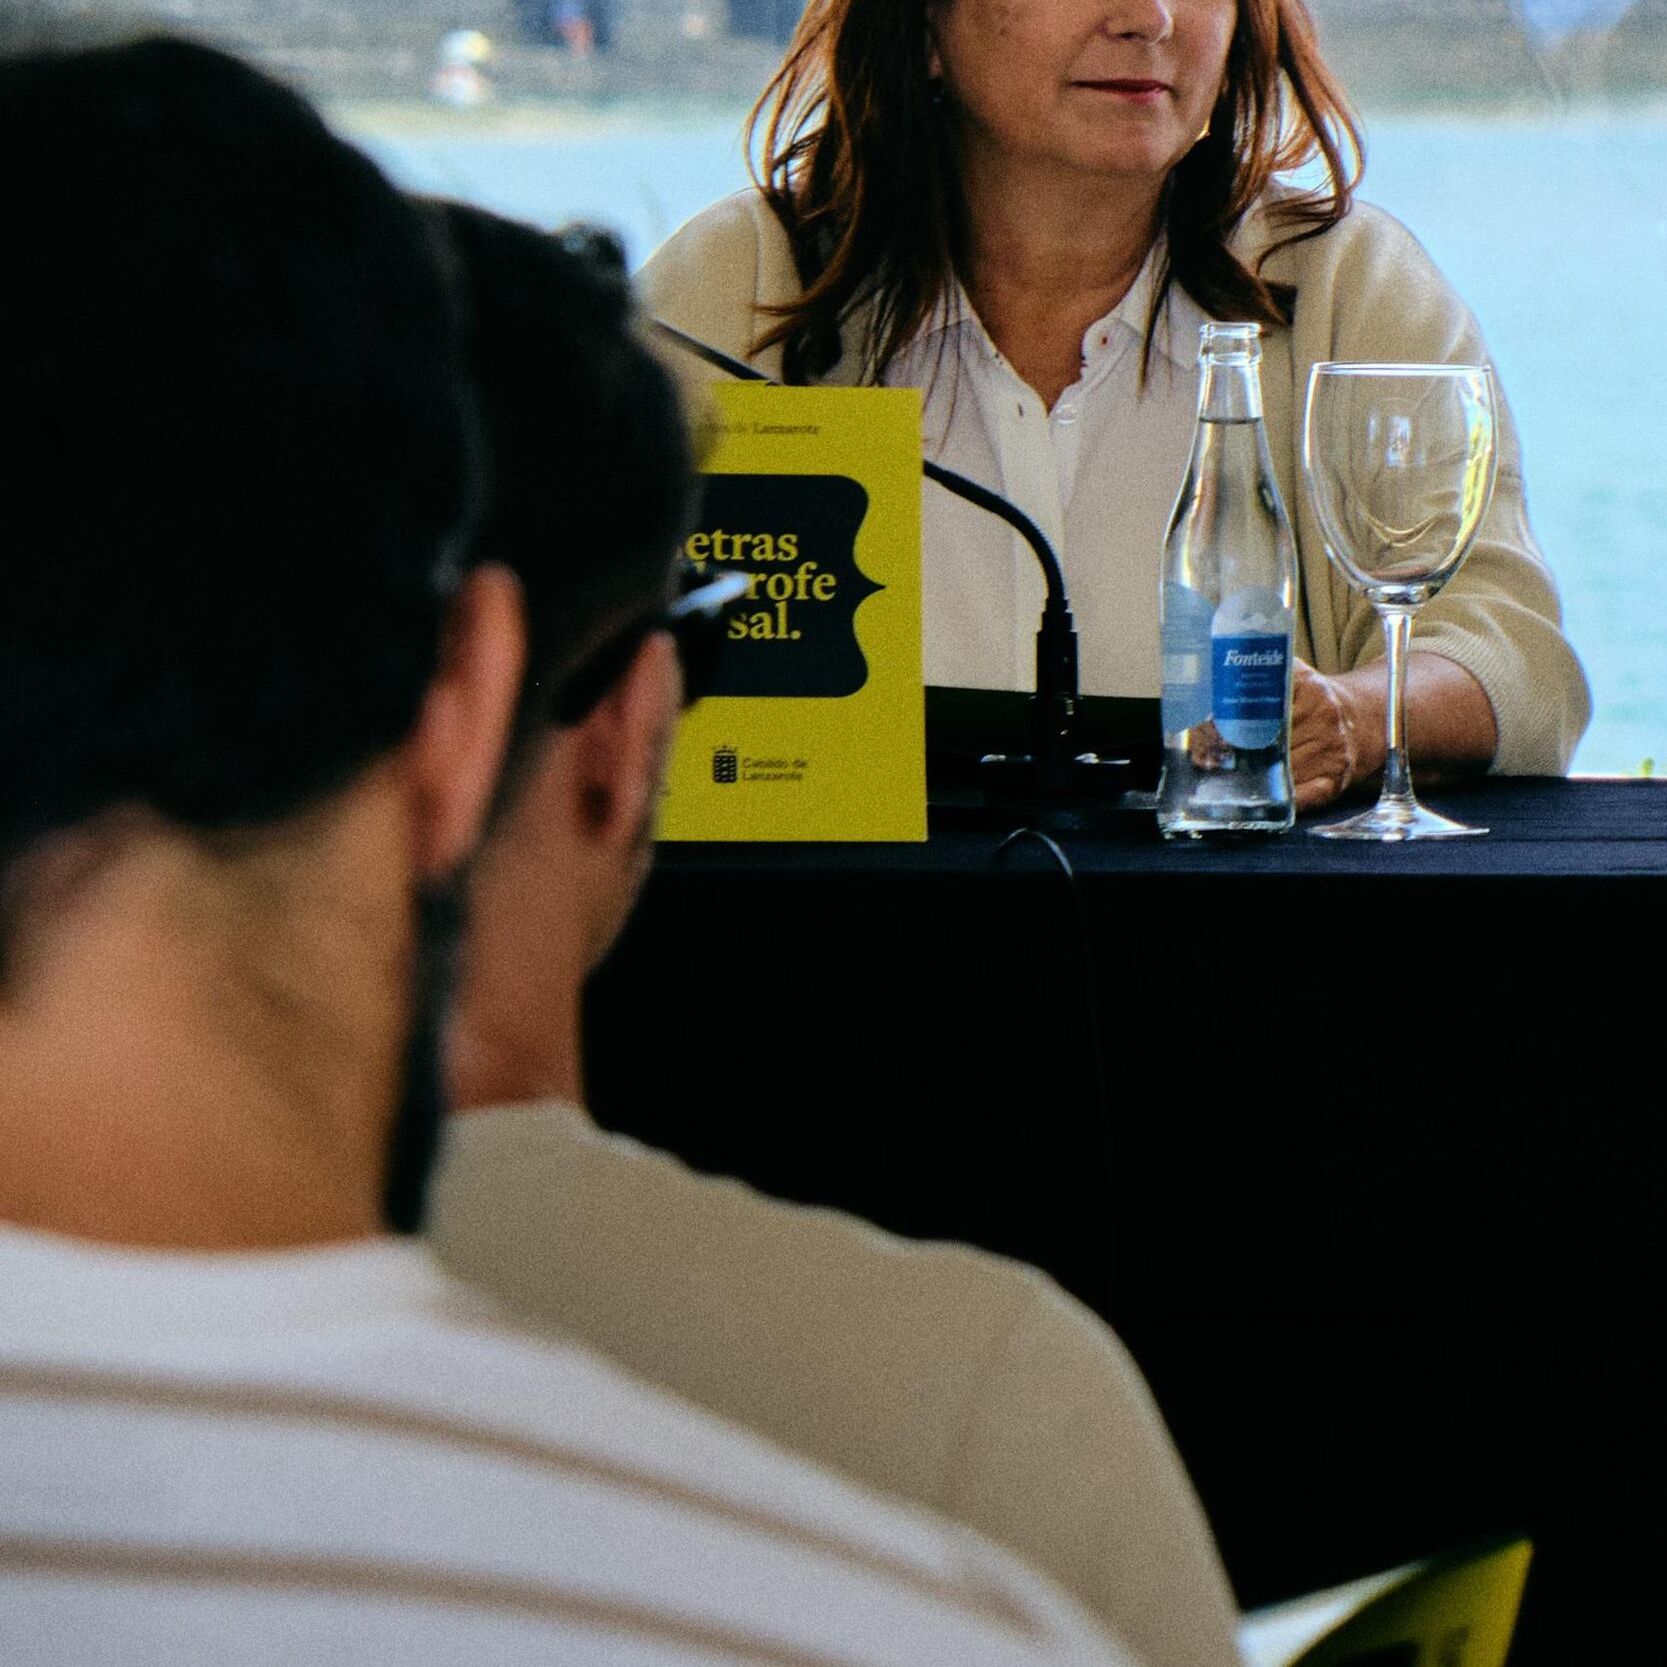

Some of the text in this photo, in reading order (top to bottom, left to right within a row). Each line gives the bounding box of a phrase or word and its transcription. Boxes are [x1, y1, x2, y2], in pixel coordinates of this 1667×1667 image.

[686, 528, 799, 561] etras
[746, 561, 837, 601] rofe
[727, 601, 802, 640] sal.
[1223, 648, 1285, 667] Fonteide
